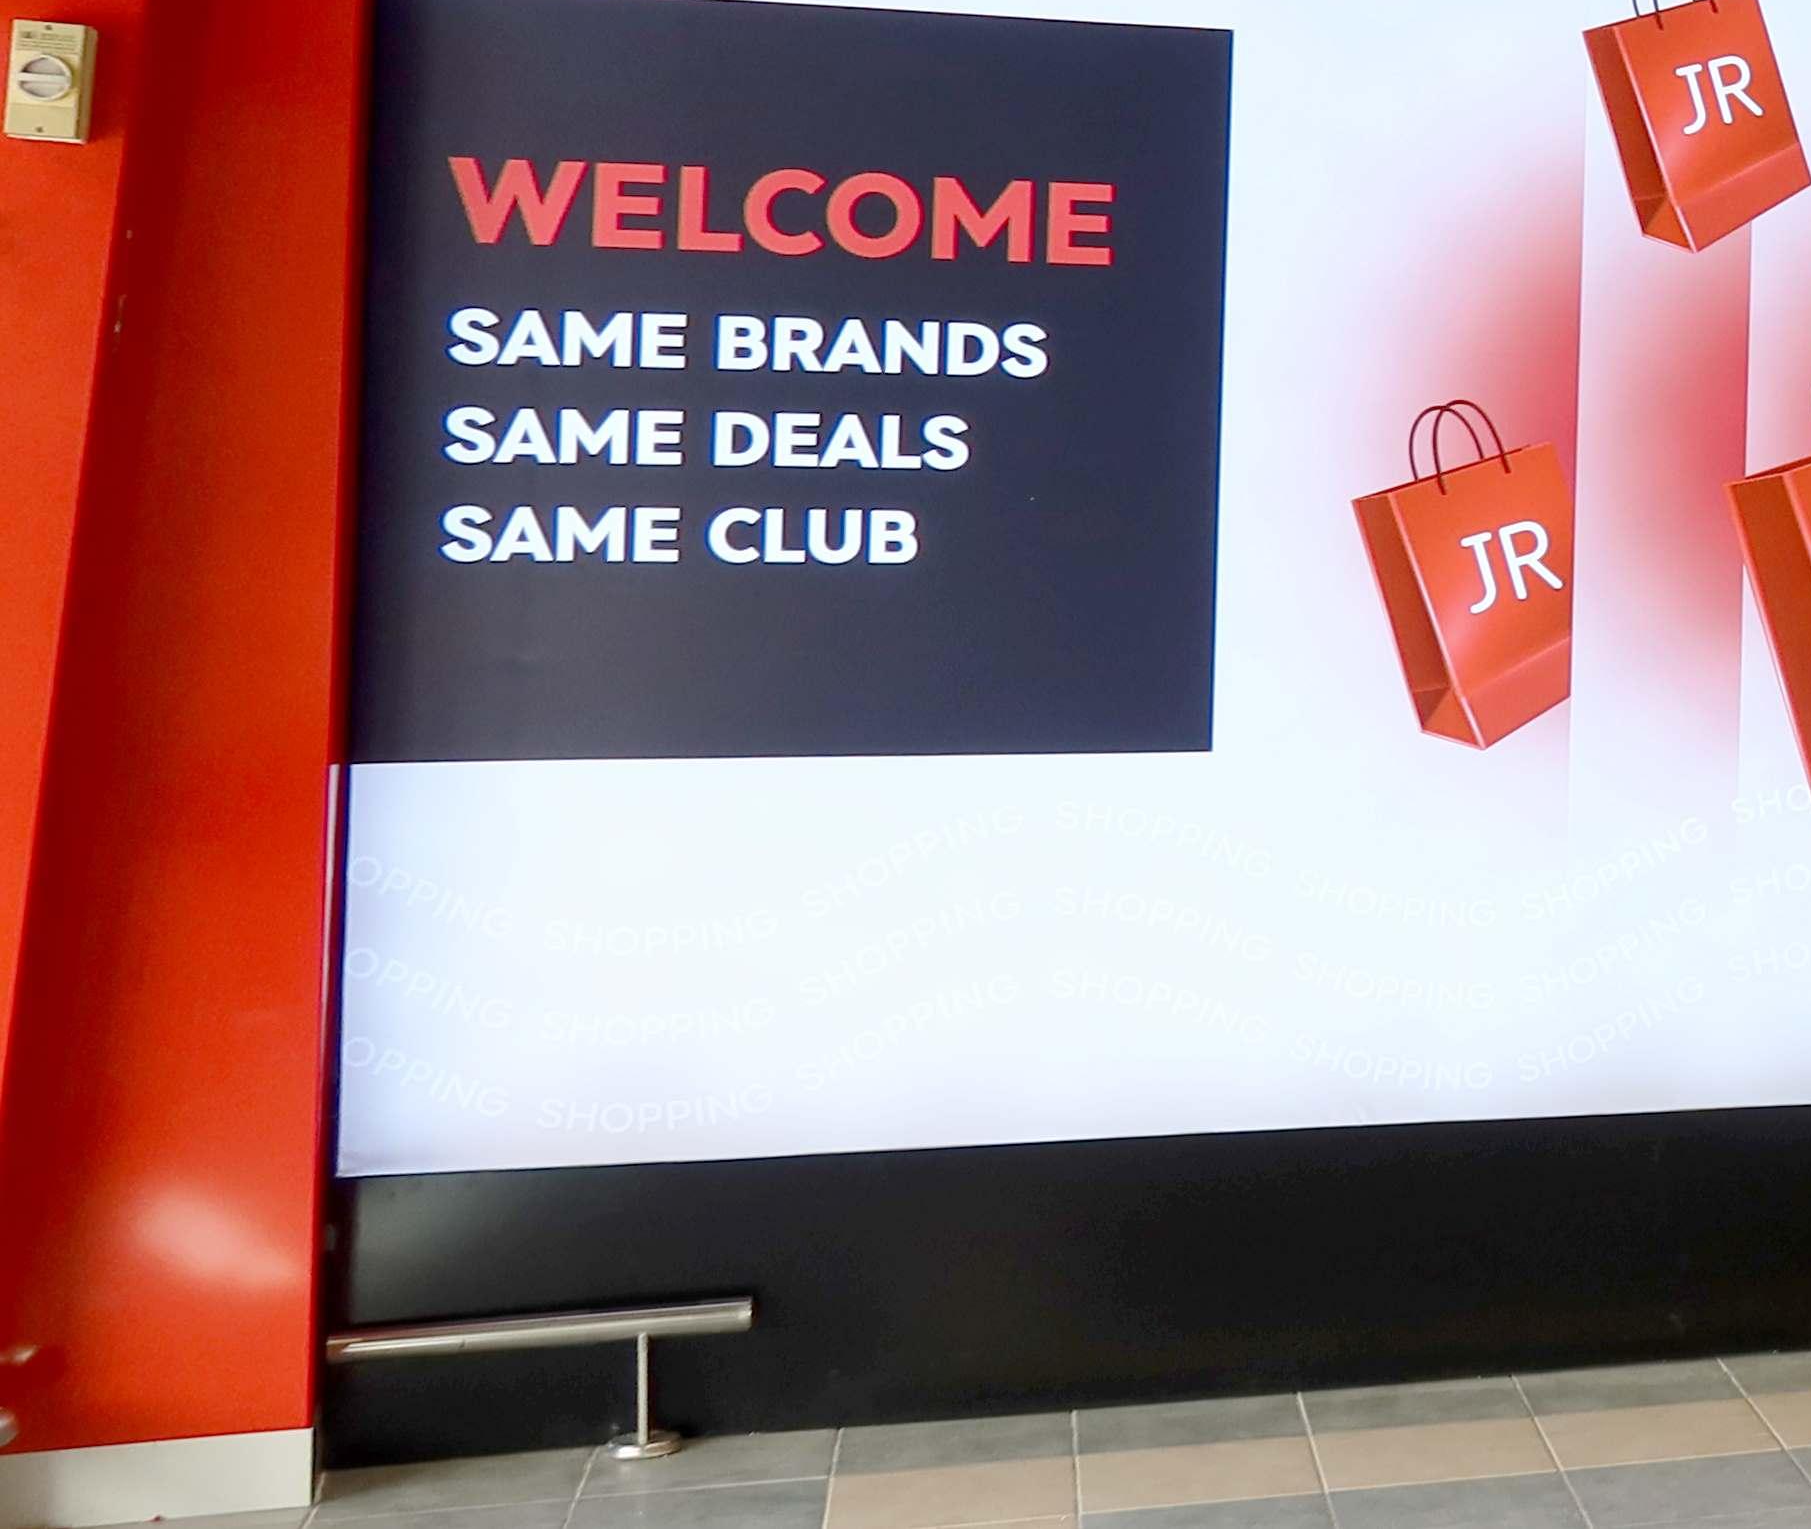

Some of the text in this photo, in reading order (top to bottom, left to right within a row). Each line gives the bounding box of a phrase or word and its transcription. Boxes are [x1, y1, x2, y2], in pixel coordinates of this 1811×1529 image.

[1673, 54, 1765, 137] JR
[447, 156, 1115, 266] WELCOME
[446, 307, 1049, 379] SAME BRANDS
[442, 406, 971, 471] SAME DEALS
[439, 504, 919, 565] SAME CLUB
[1459, 518, 1564, 616] JR
[346, 855, 514, 939] OPPING
[544, 908, 779, 959] SHOPPING
[800, 804, 1025, 919] SHOPPING
[1055, 800, 1273, 880] SHOPPING
[1294, 867, 1498, 928] SHOPPING
[1521, 816, 1709, 922] SHOPPING
[345, 886, 1707, 1047] OPPING SHOPPING SHOPPING SHOPPING SHOPPING SHOPPING
[343, 1036, 511, 1118] OPPING
[536, 1082, 774, 1133] SHOPPING
[794, 973, 1020, 1091] SHOPPING
[1050, 968, 1270, 1045] SHOPPING
[1290, 1031, 1494, 1091] SHOPPING
[1516, 975, 1706, 1084] SHOPPING
